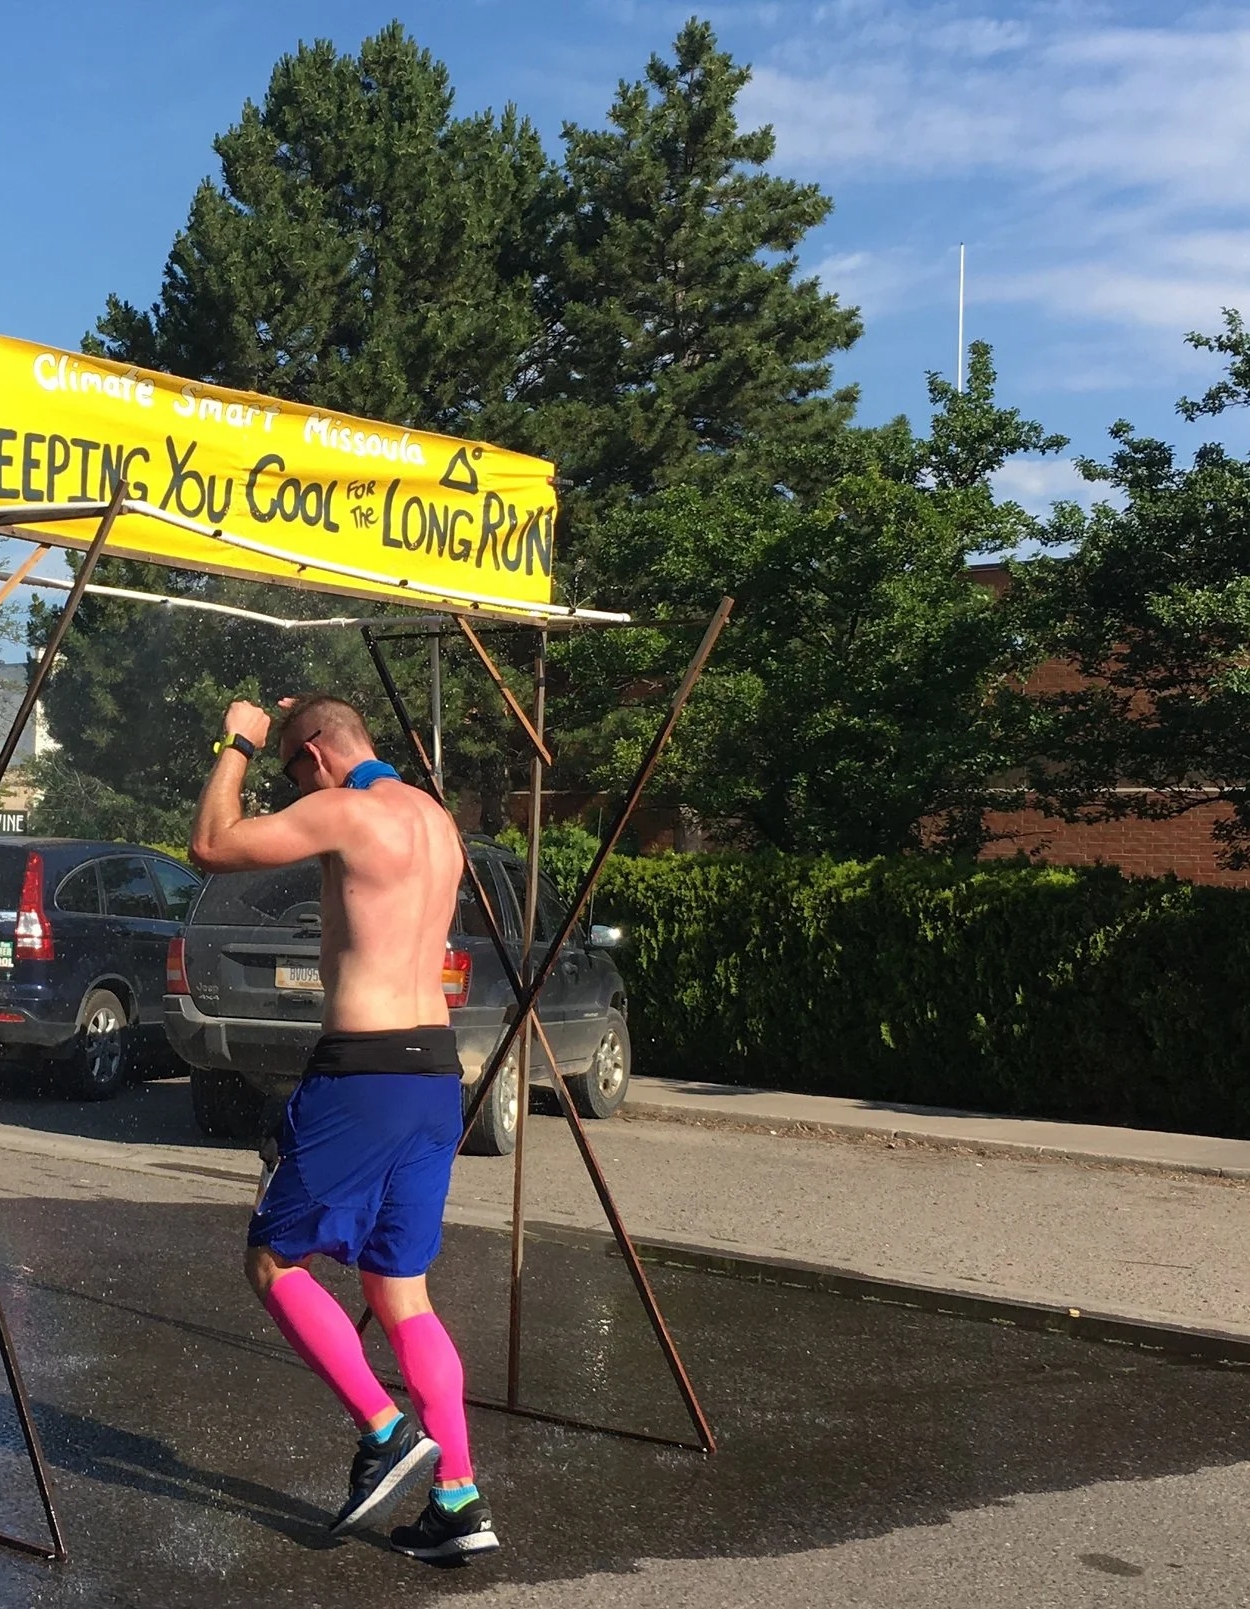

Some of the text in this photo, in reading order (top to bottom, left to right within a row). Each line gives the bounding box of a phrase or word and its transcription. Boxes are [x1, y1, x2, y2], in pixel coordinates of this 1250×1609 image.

[33, 352, 427, 466] Climate Smart Missoula
[245, 453, 340, 533] COOL
[347, 480, 377, 500] FOR
[382, 478, 474, 563] LONG
[475, 491, 554, 577] RUN
